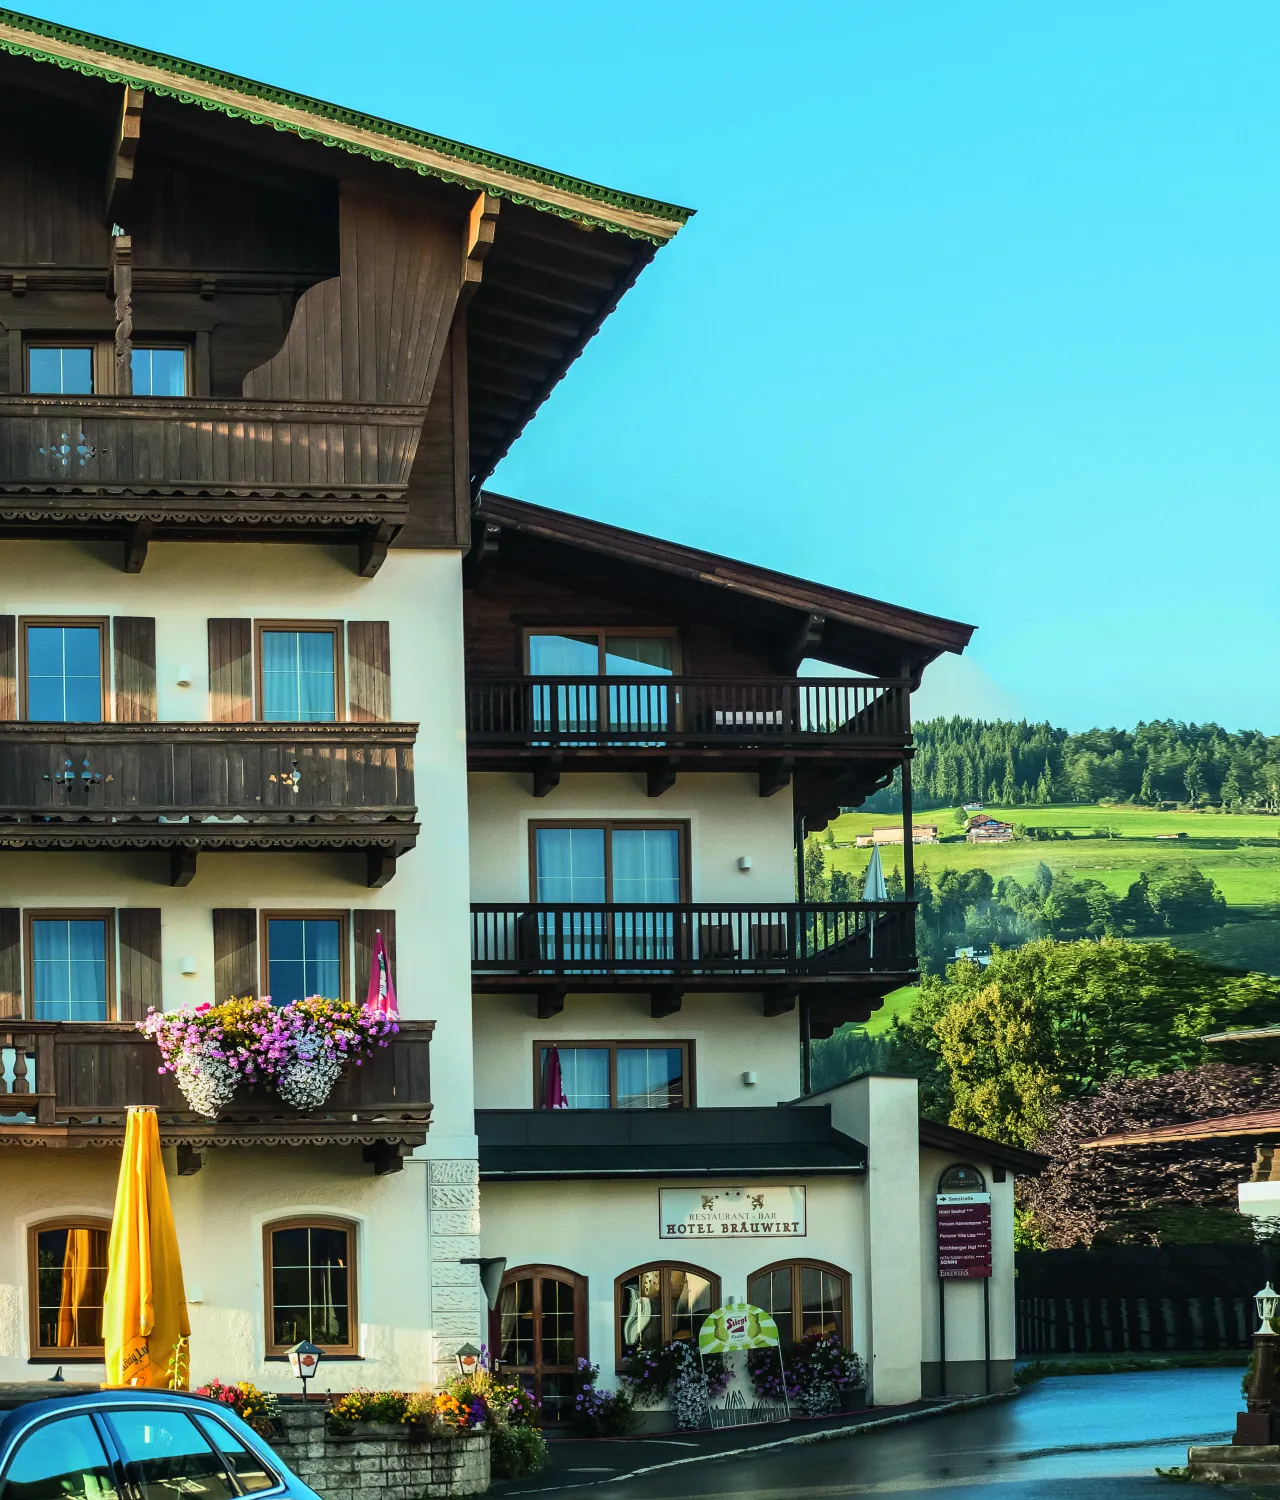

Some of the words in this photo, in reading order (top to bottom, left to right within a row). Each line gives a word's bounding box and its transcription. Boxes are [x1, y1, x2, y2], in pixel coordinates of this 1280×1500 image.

[689, 1212, 750, 1221] RESTAURANT
[758, 1212, 777, 1220] BAR
[666, 1223, 715, 1235] HOTEL
[721, 1221, 800, 1234] BRÄUWIRT
[726, 1315, 748, 1331] Stiegl
